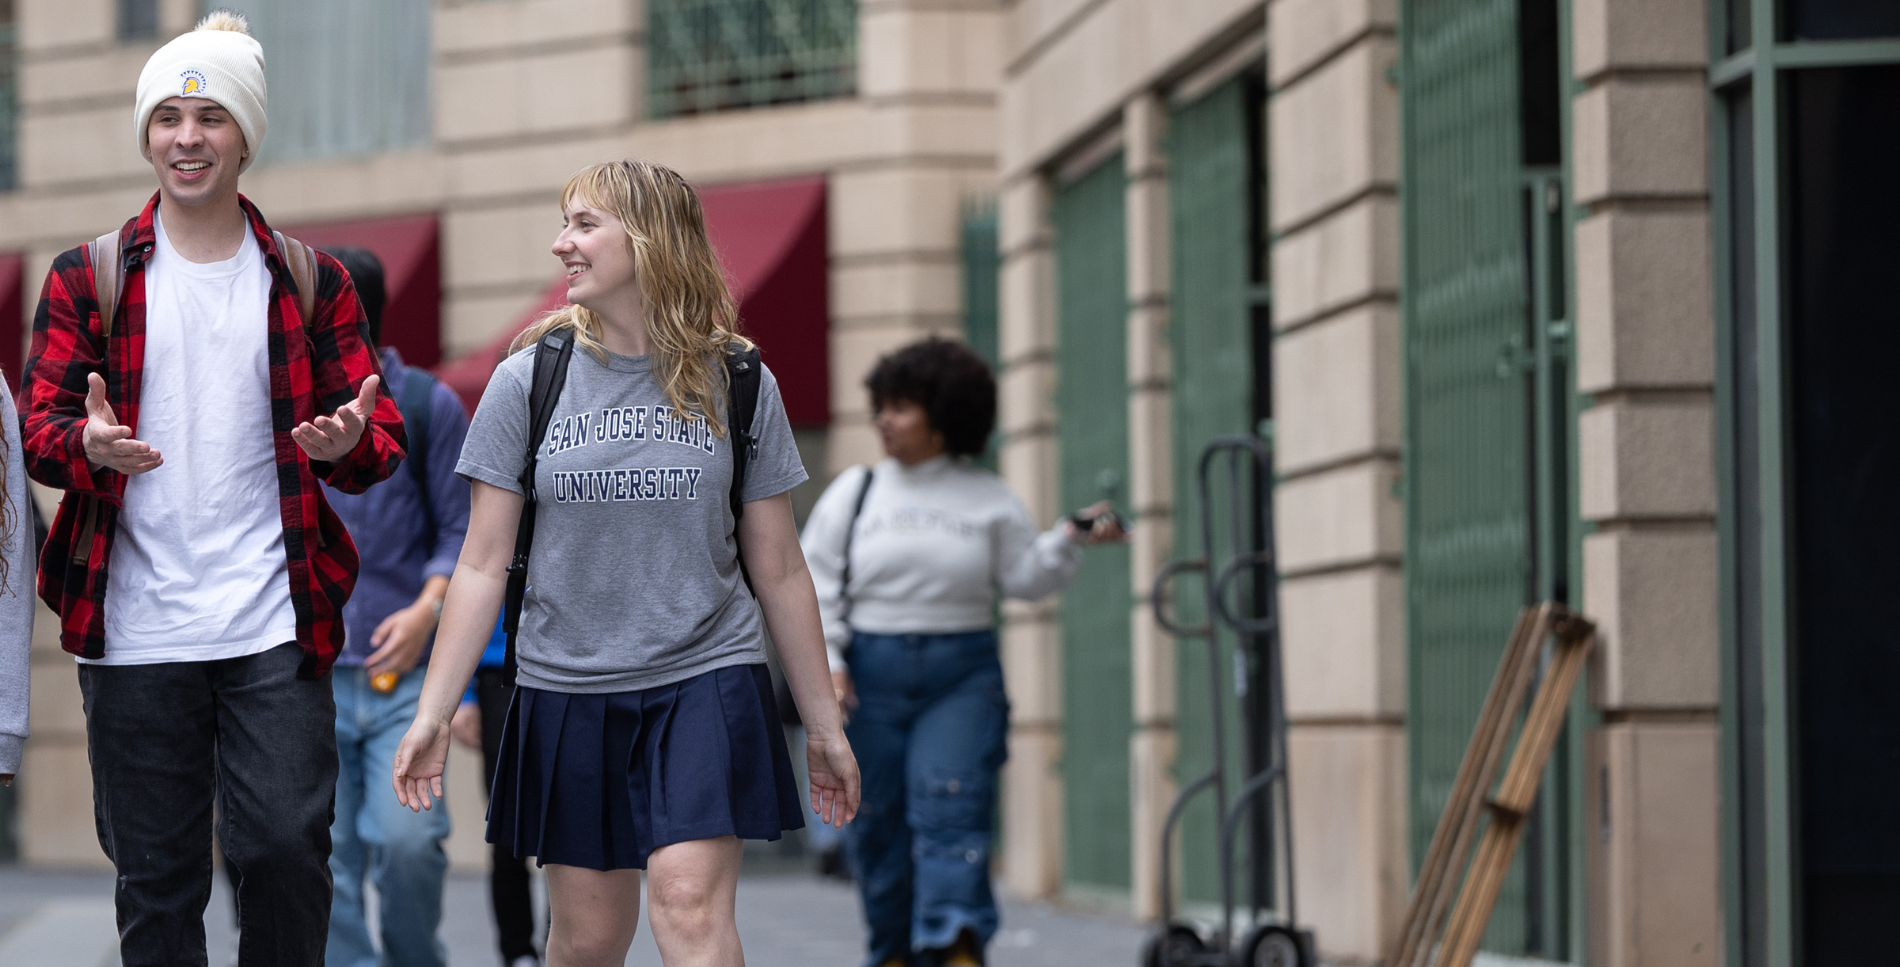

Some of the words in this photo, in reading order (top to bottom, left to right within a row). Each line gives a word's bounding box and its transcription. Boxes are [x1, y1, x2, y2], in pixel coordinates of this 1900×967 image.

[547, 412, 592, 457] SAN
[595, 406, 647, 443] JOSE
[653, 405, 715, 456] STATE
[553, 467, 702, 503] UNIVERSITY
